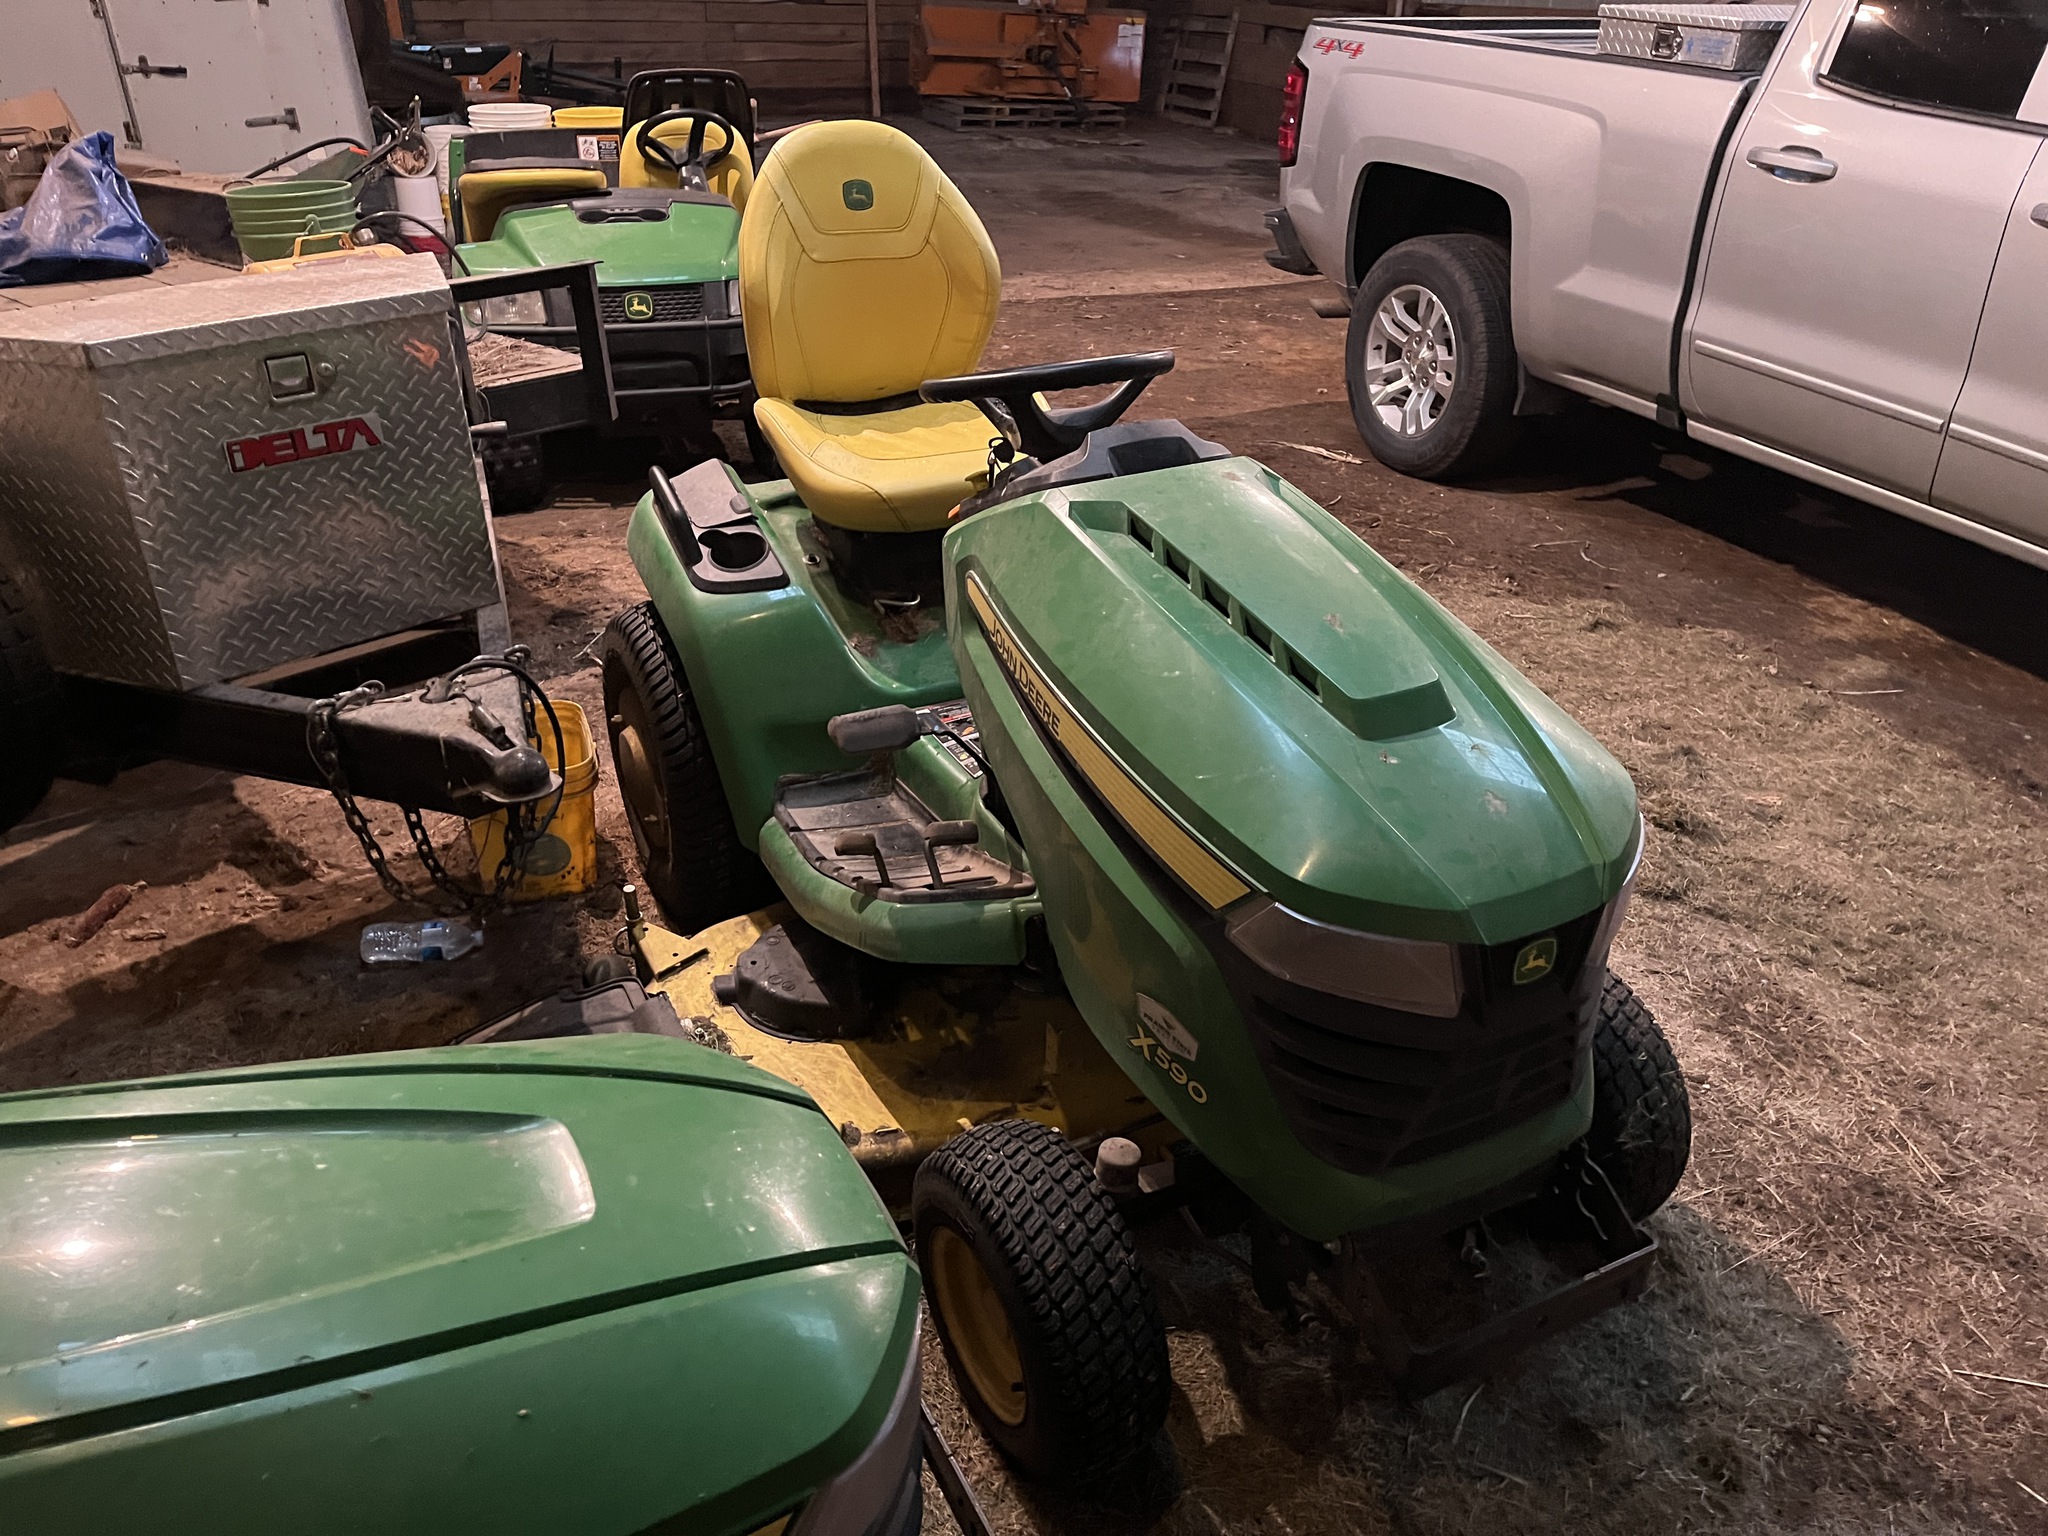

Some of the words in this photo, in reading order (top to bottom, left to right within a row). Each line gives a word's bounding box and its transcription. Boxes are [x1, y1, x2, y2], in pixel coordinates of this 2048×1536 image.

[990, 619, 1017, 679] JOHN
[1019, 660, 1060, 738] DEERE
[1129, 1023, 1208, 1104] X590
